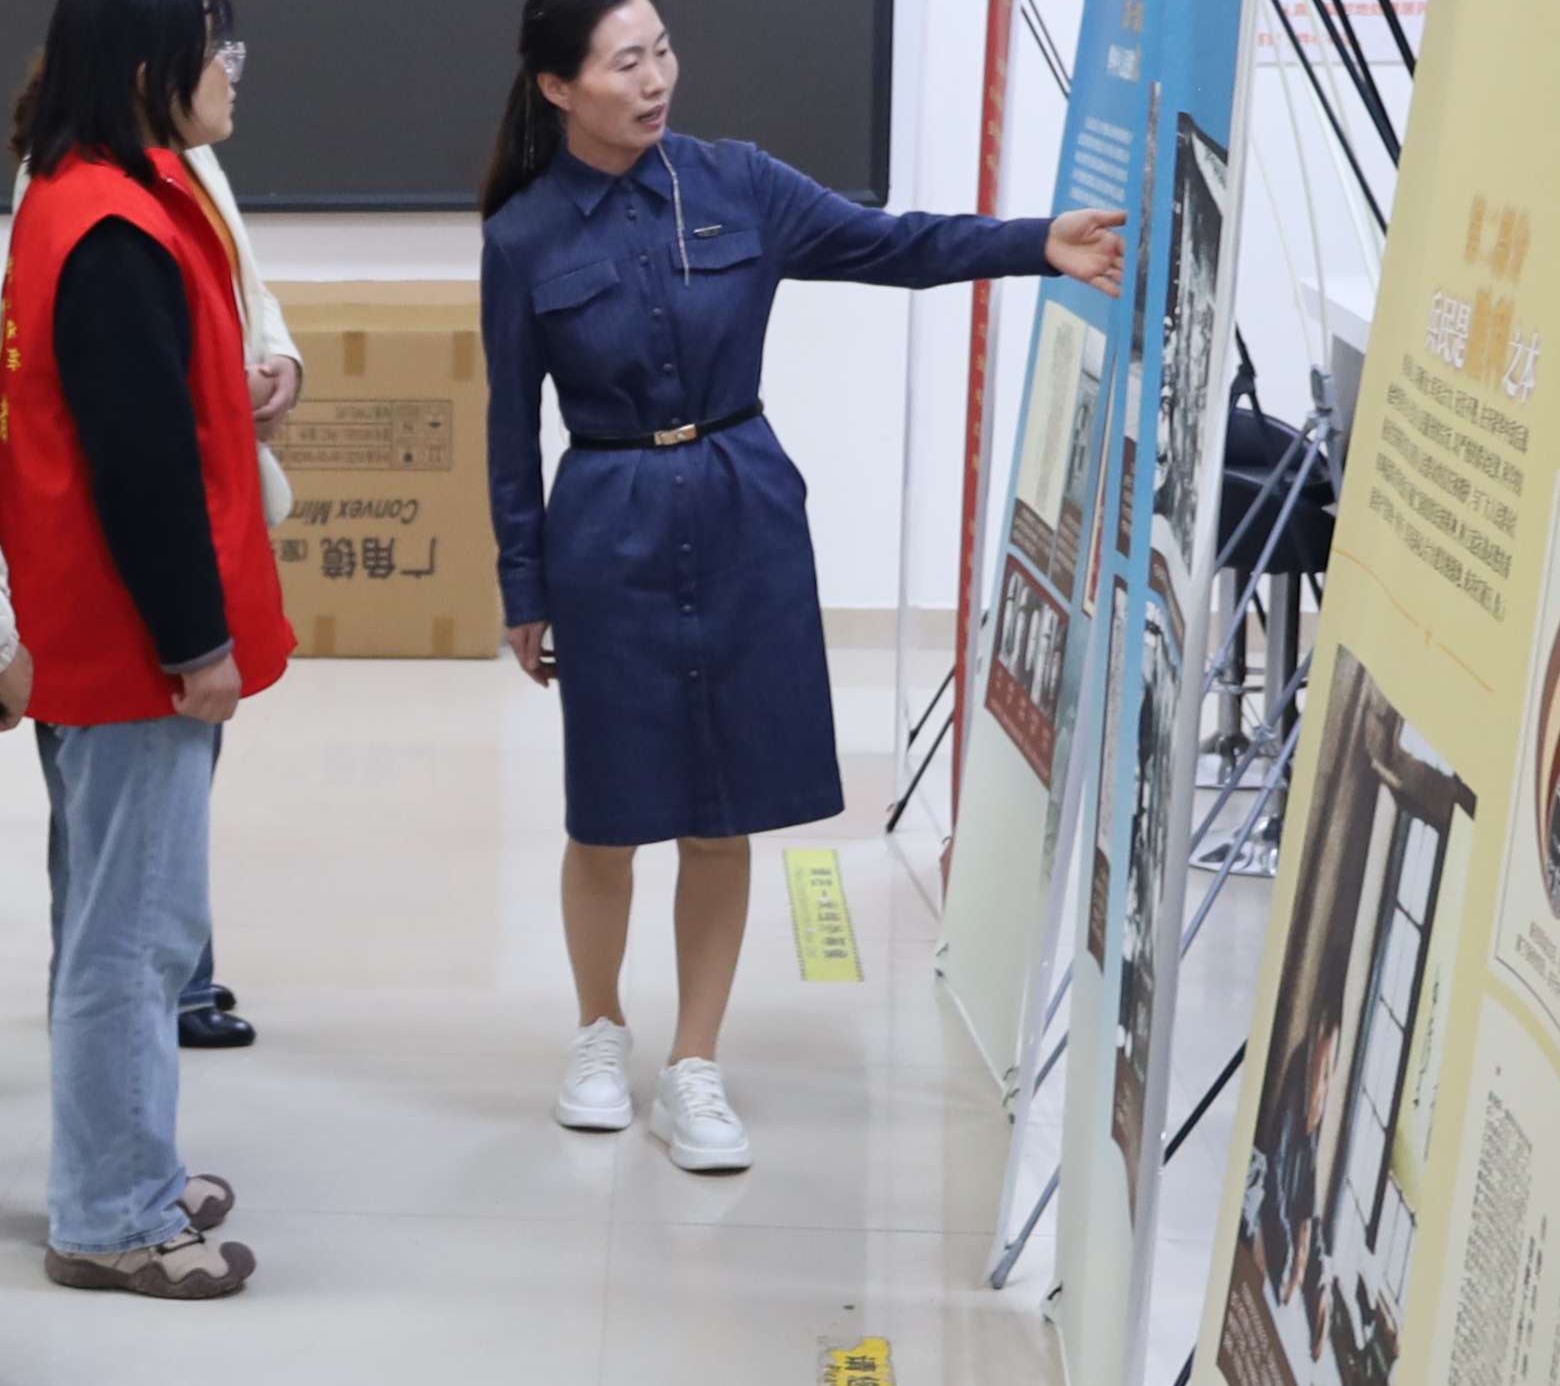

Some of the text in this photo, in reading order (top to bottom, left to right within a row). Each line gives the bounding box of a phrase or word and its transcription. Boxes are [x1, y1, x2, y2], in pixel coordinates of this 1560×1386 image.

[335, 498, 419, 526] Convex
[320, 536, 438, 580] 广角镜
